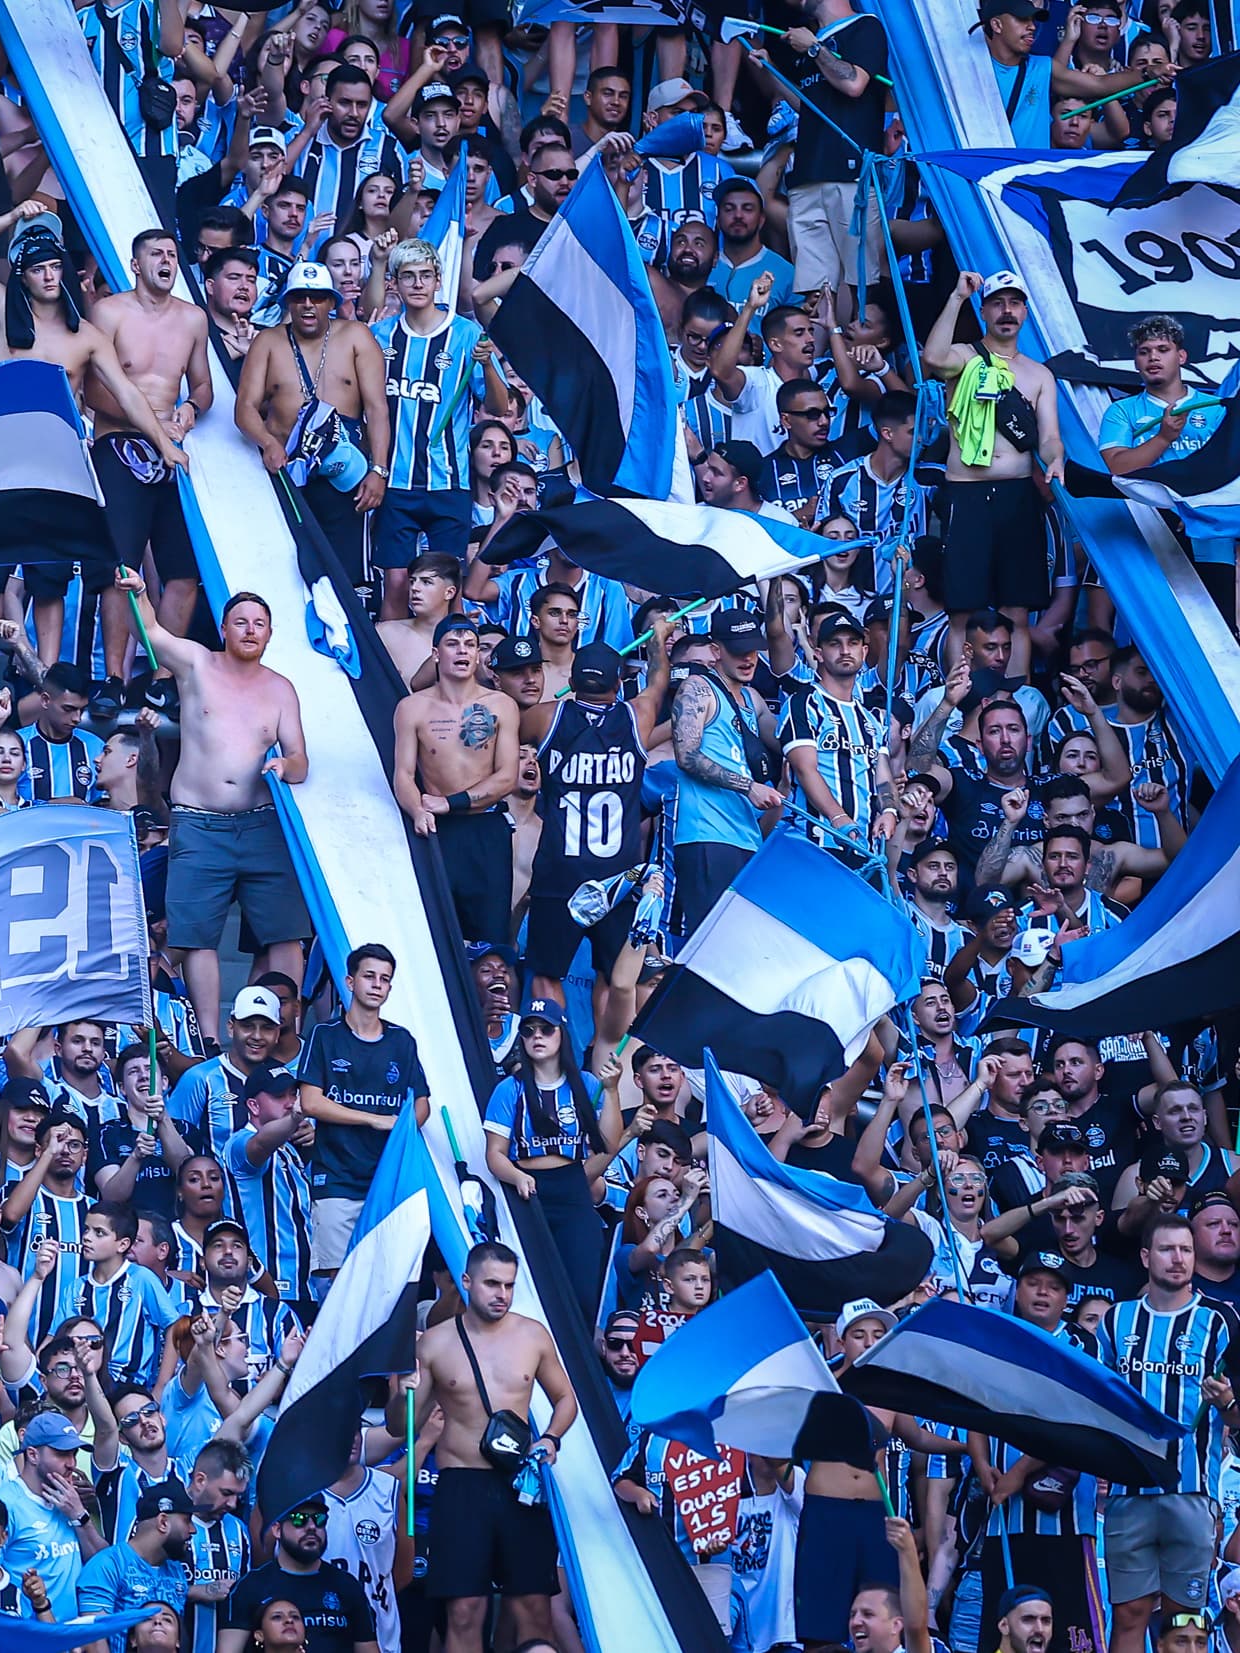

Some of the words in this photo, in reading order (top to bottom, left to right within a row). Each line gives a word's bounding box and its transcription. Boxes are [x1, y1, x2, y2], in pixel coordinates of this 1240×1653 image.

[1081, 230, 1240, 296] 190
[560, 791, 623, 857] 10
[344, 1089, 400, 1108] banrisul
[1131, 1358, 1200, 1378] banrisul
[680, 1485, 742, 1516] QUASE!
